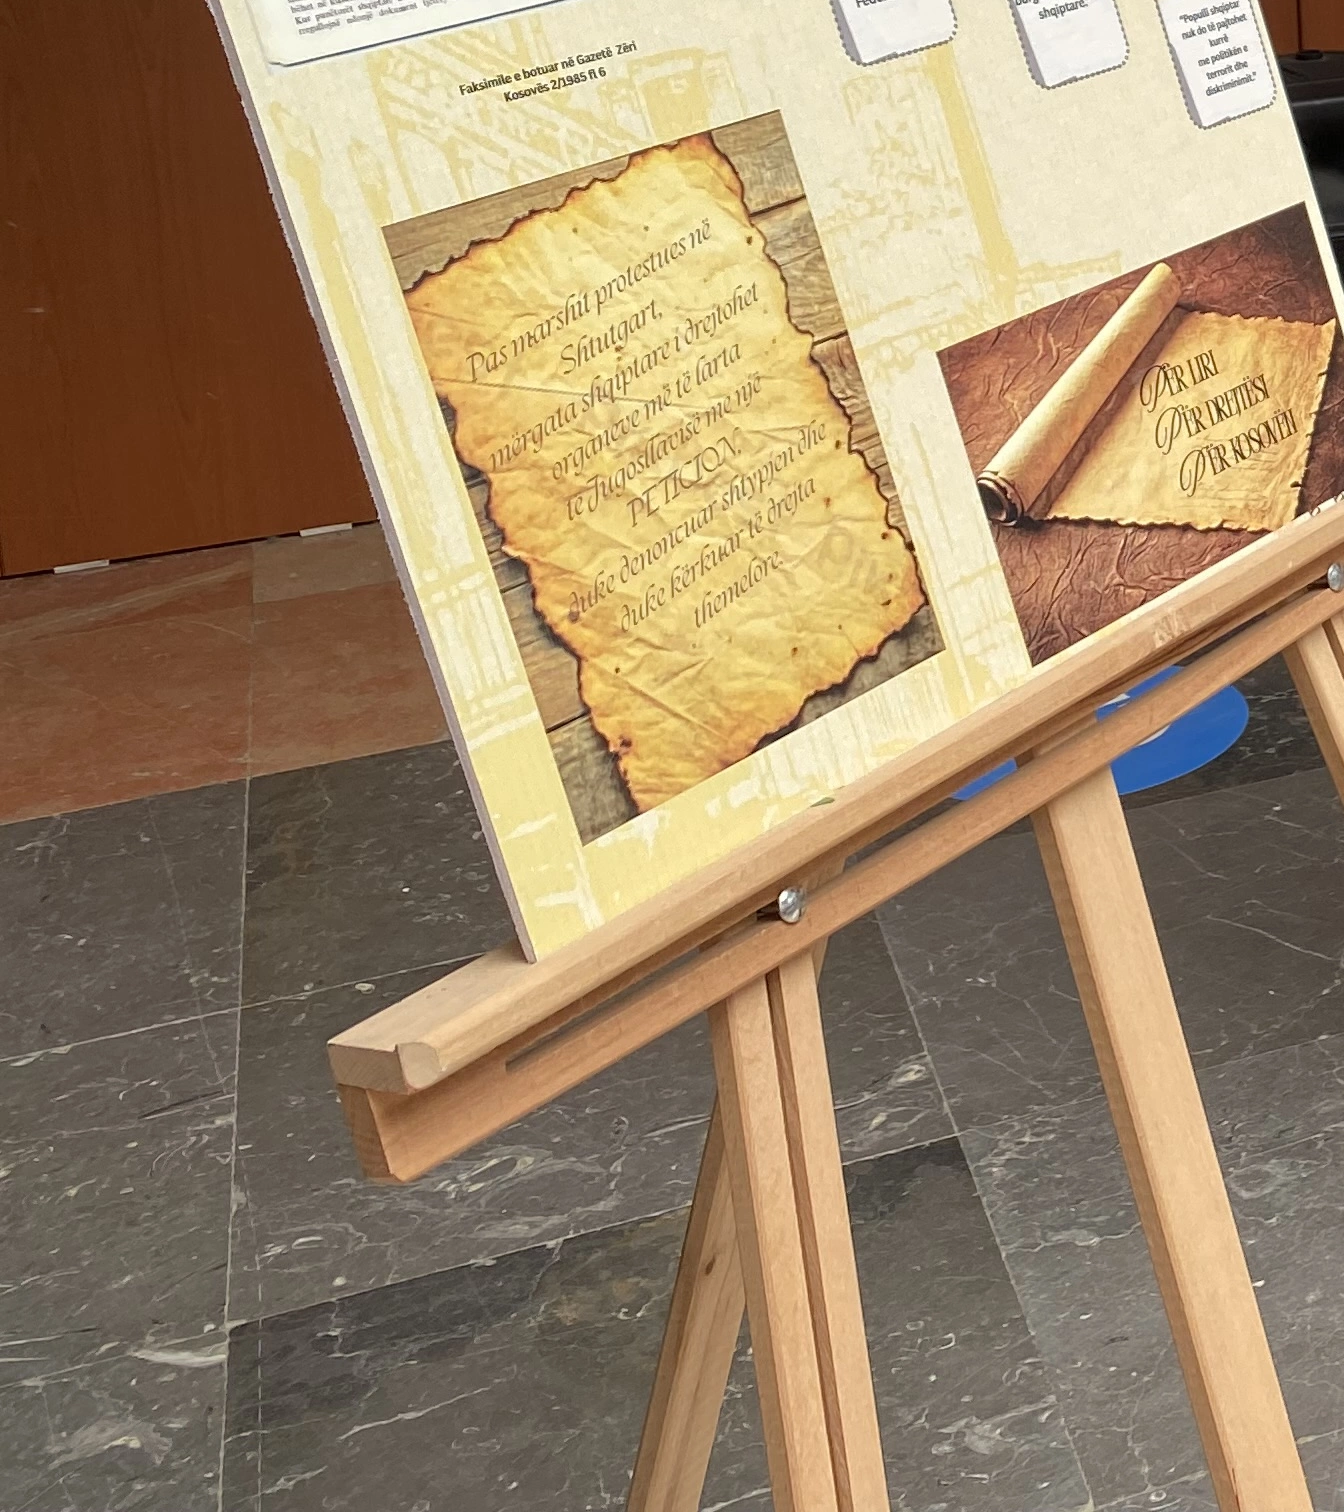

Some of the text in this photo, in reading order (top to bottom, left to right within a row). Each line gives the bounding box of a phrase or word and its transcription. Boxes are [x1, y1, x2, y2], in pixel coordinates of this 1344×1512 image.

[458, 40, 637, 95] Faksimile e botuar në Gazetë Zëri
[503, 82, 549, 102] Kosovës
[549, 71, 587, 89] 2/1985
[597, 66, 606, 77] 6
[466, 218, 711, 382] Pas marshit protestues në
[559, 298, 664, 375] Shtutgart,
[488, 282, 759, 471] mërgata shqiptare i drejtohet
[1139, 350, 1219, 413] PËR LIRI
[1155, 374, 1270, 455] PËR DREJTËSI
[1180, 408, 1298, 498] PËR KOSOVËN
[621, 478, 817, 633] duke kërkuar të drejta
[693, 550, 784, 628] themelore.
